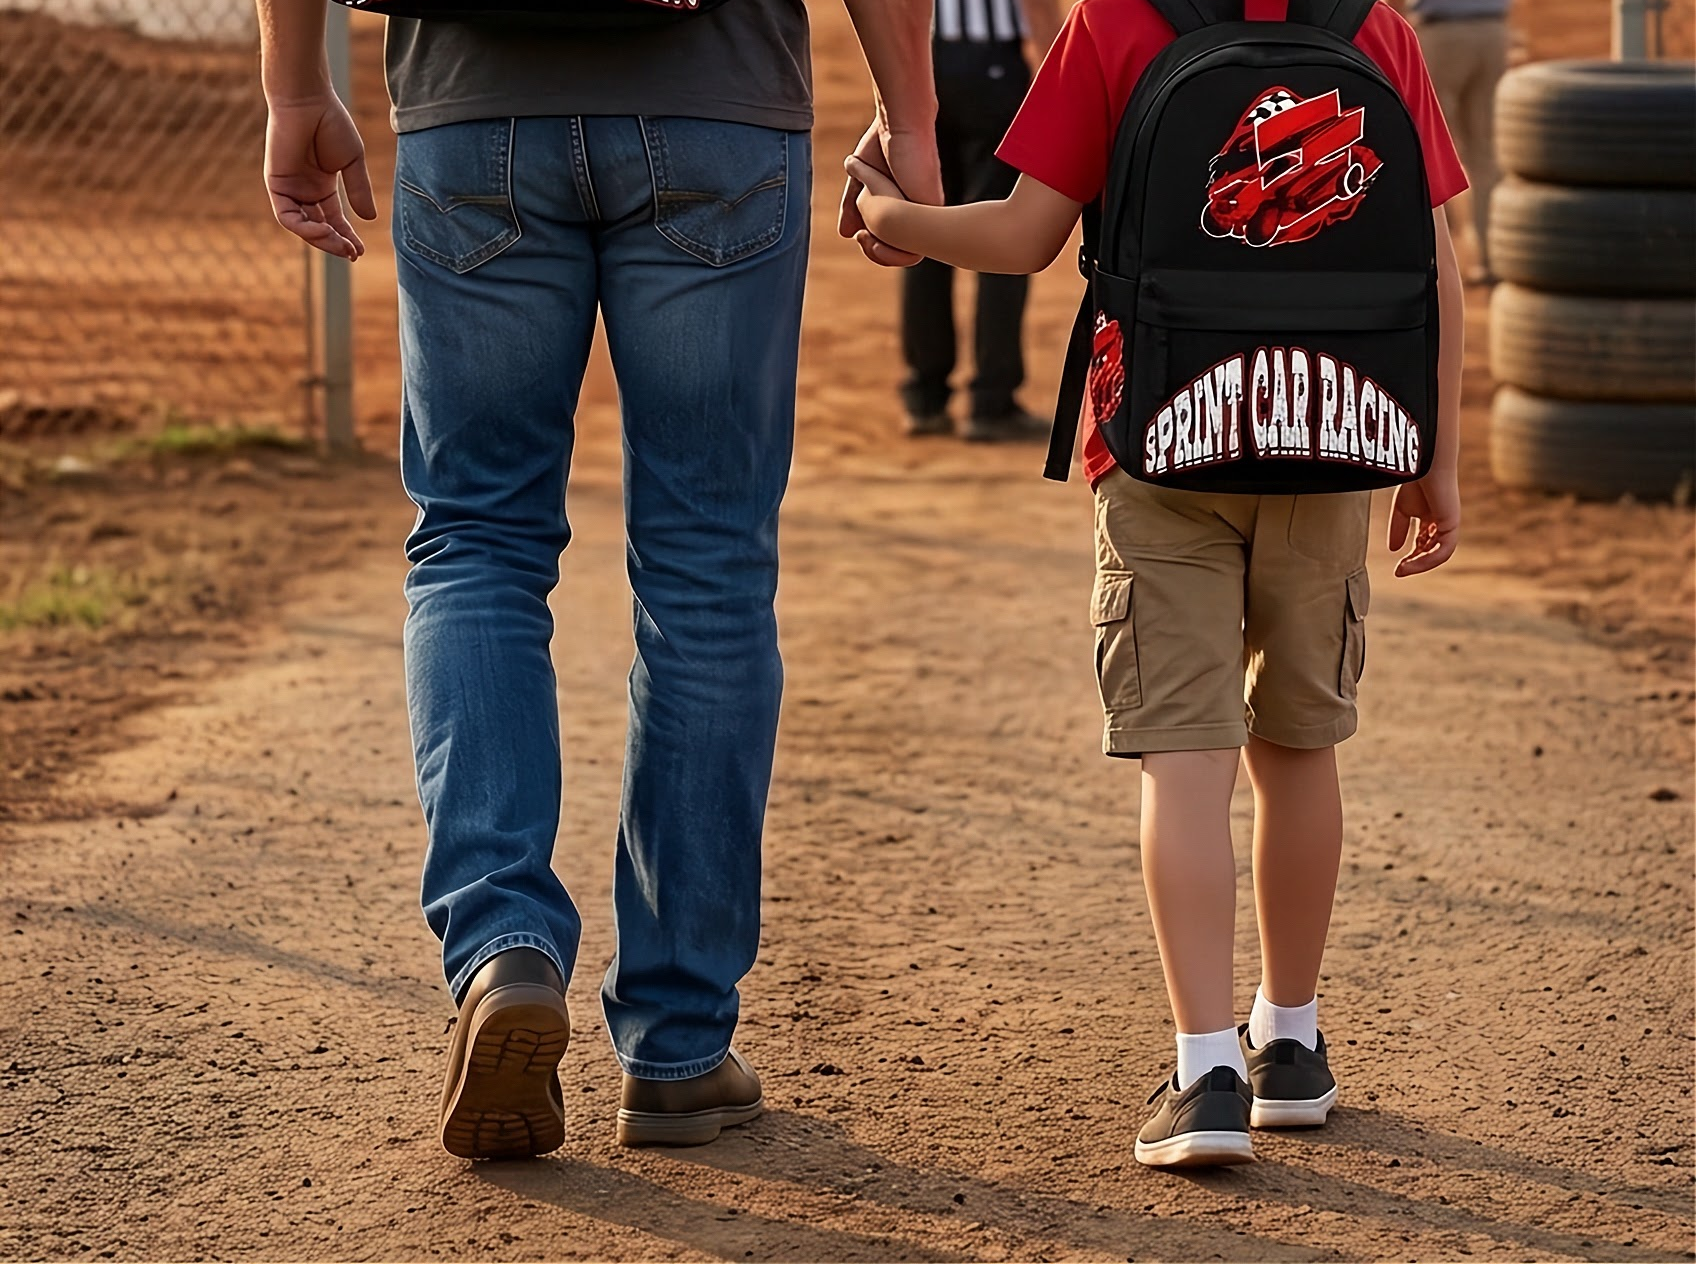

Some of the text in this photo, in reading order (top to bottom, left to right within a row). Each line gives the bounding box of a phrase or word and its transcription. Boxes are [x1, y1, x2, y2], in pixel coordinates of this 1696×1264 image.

[1145, 348, 1420, 475] SPRINT CAR RACING
